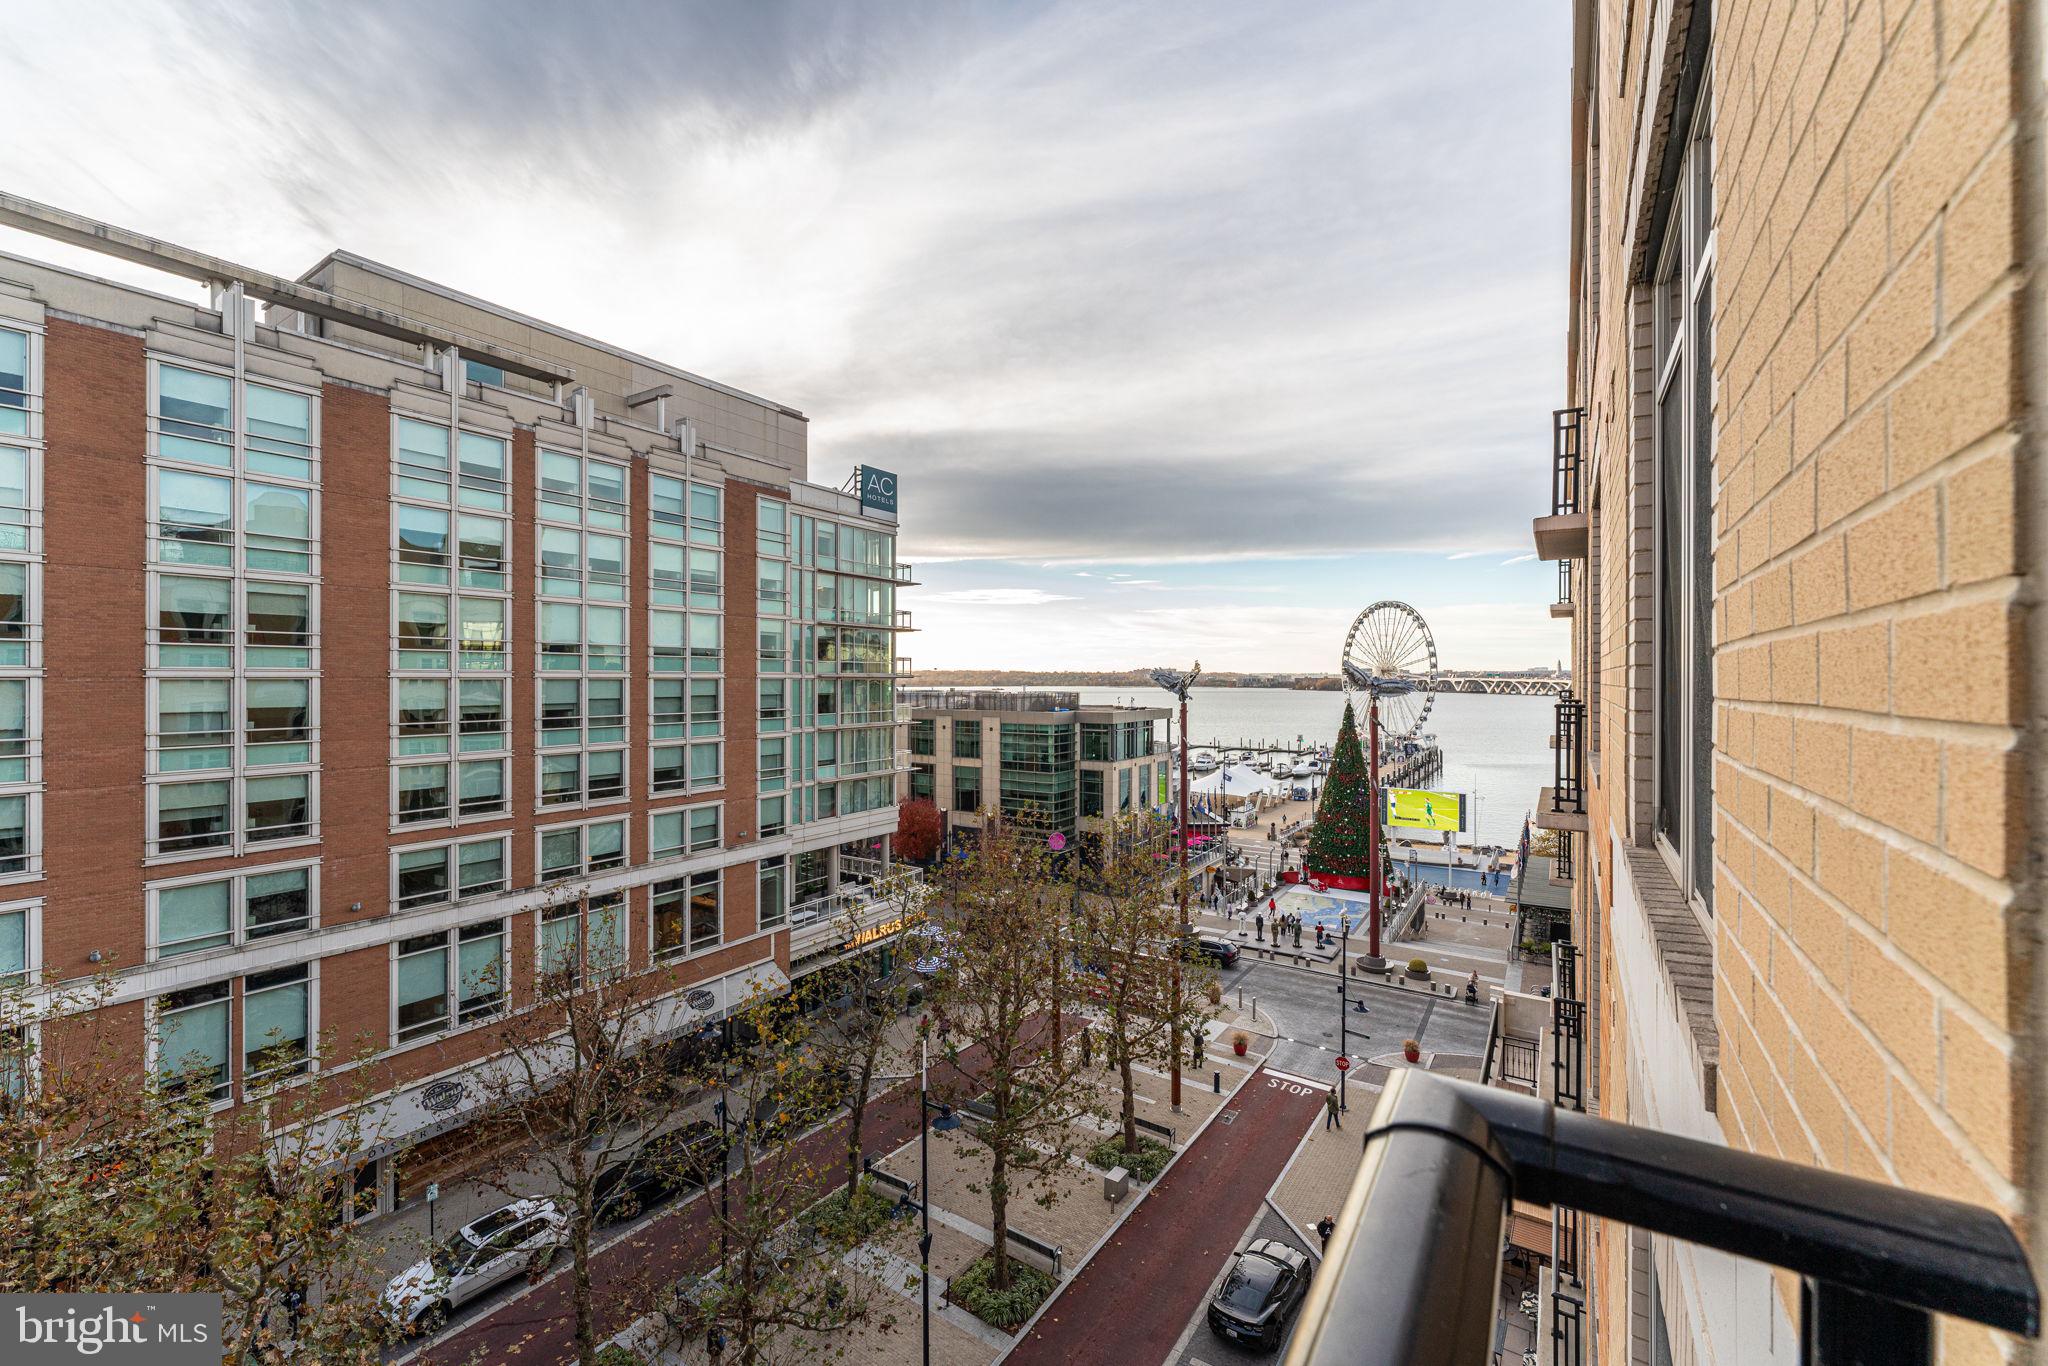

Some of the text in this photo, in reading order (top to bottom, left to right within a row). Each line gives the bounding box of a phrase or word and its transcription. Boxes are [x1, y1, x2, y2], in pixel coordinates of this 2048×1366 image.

[867, 474, 893, 496] AC
[867, 493, 894, 505] HOTELS
[854, 919, 902, 946] WALRUS
[1267, 1078, 1313, 1096] STOP
